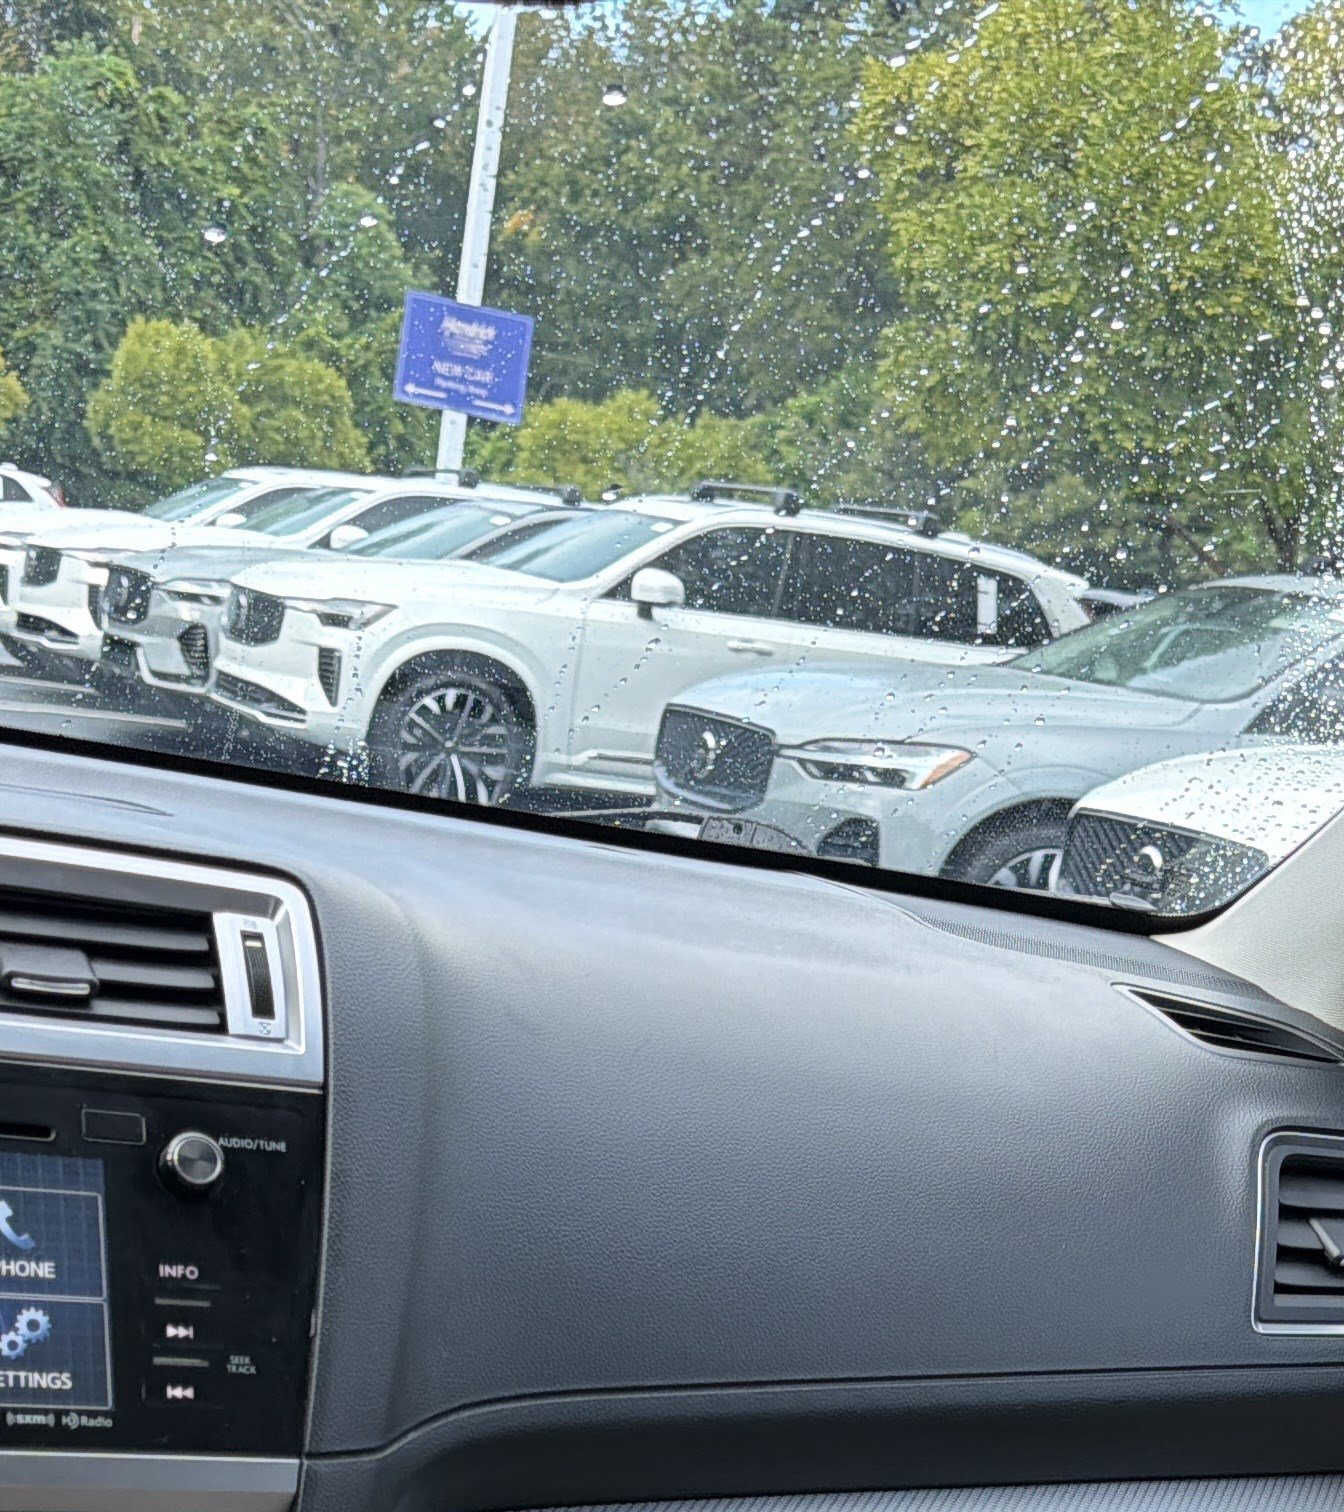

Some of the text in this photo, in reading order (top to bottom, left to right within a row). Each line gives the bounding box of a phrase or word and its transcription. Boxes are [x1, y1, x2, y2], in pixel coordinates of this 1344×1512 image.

[219, 1137, 287, 1152] AUDIO/TUNE
[159, 1264, 199, 1280] INFO
[81, 1415, 113, 1428] Radio
